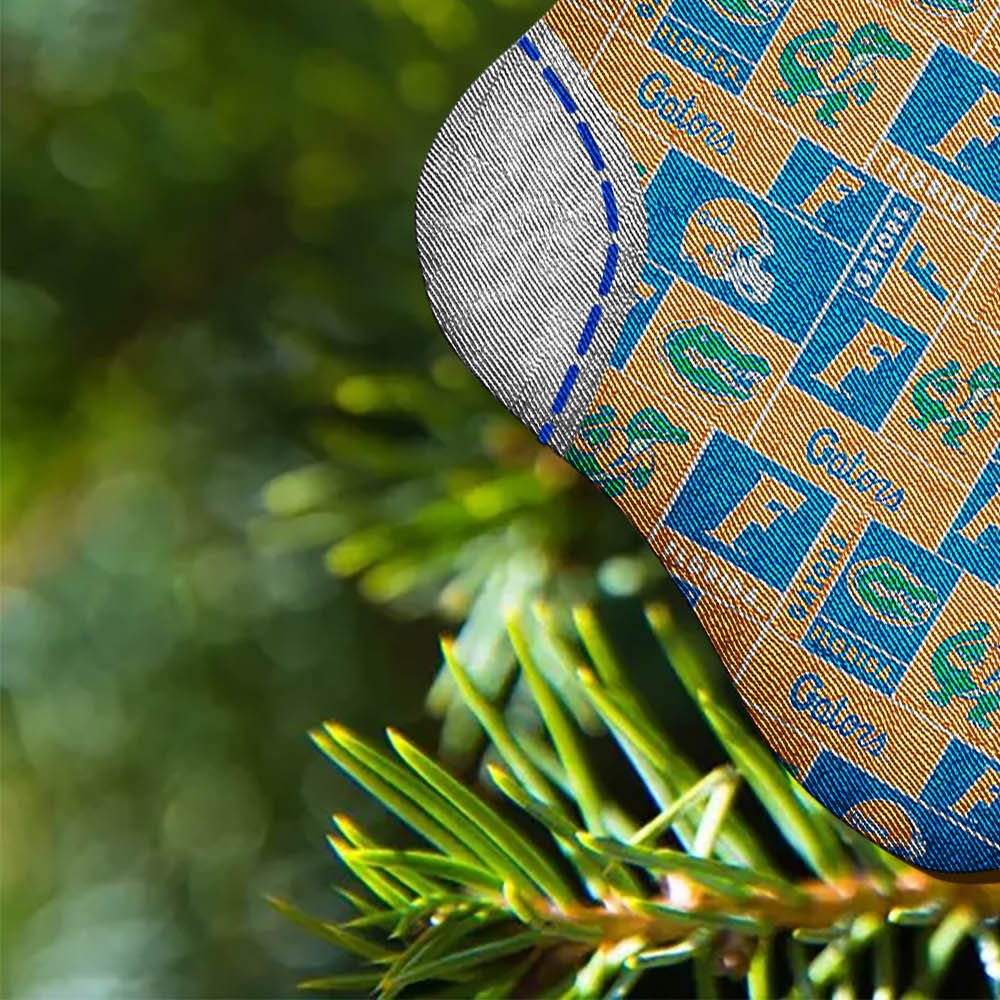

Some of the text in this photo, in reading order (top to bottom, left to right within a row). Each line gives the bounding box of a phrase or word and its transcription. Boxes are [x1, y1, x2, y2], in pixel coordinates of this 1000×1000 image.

[655, 22, 743, 85] FLORIDA
[638, 73, 734, 155] Gators
[794, 167, 865, 222] F
[883, 154, 984, 226] FLORIDA
[851, 206, 912, 291] GATORS
[810, 320, 907, 397] F
[805, 428, 902, 512] Gators
[703, 471, 807, 554] F
[784, 532, 849, 622] GATORS
[807, 624, 895, 686] FLORIDA
[790, 674, 886, 757] Gators
